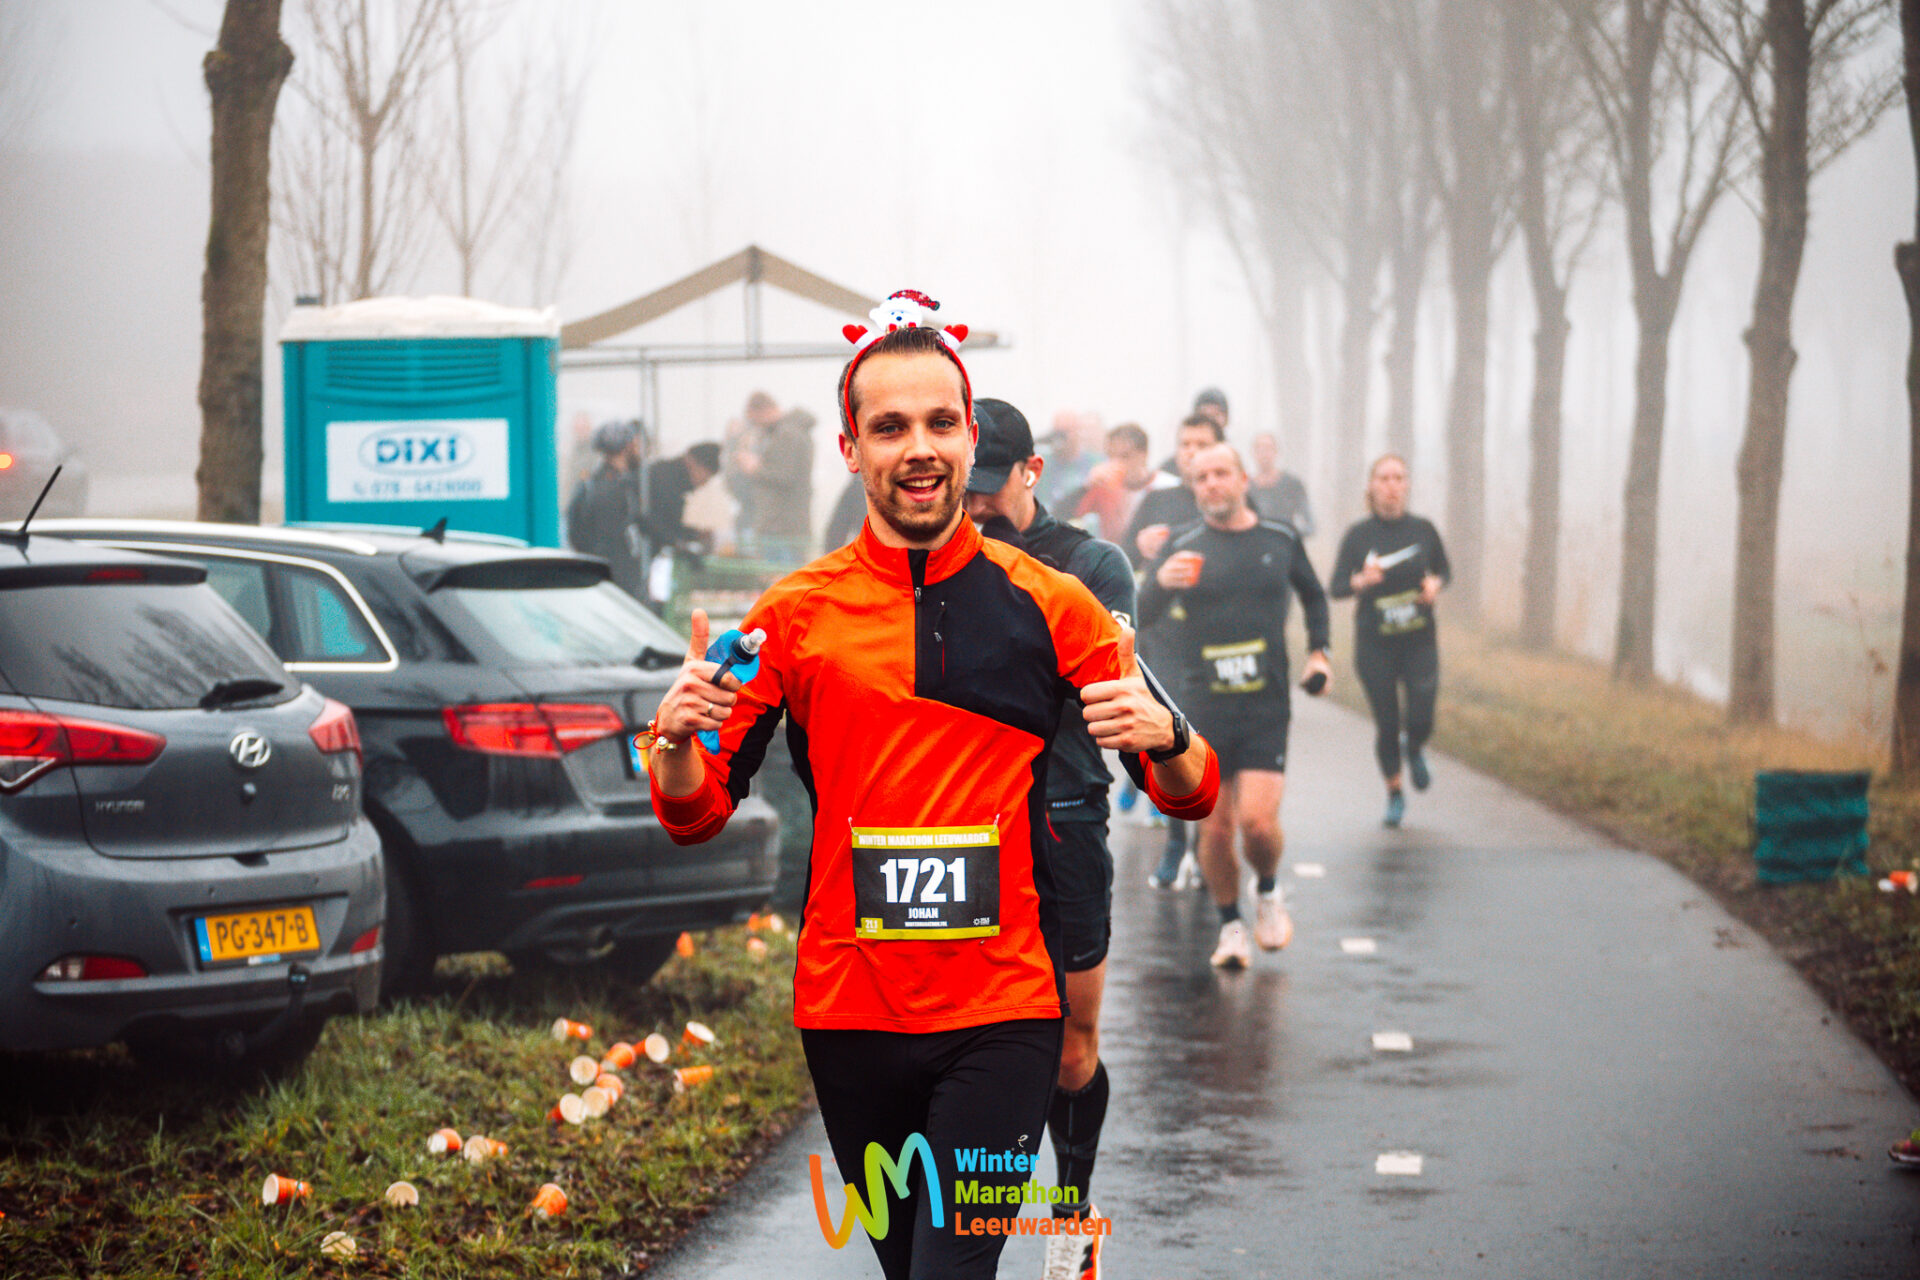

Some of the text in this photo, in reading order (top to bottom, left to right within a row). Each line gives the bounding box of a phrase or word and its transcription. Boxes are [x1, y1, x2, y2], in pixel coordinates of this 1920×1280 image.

[858, 832, 990, 846] WINTER MARATHON LEEUWARDEN
[879, 857, 966, 903] 1721
[908, 907, 939, 919] JOHAN
[215, 913, 309, 953] PG-347-B
